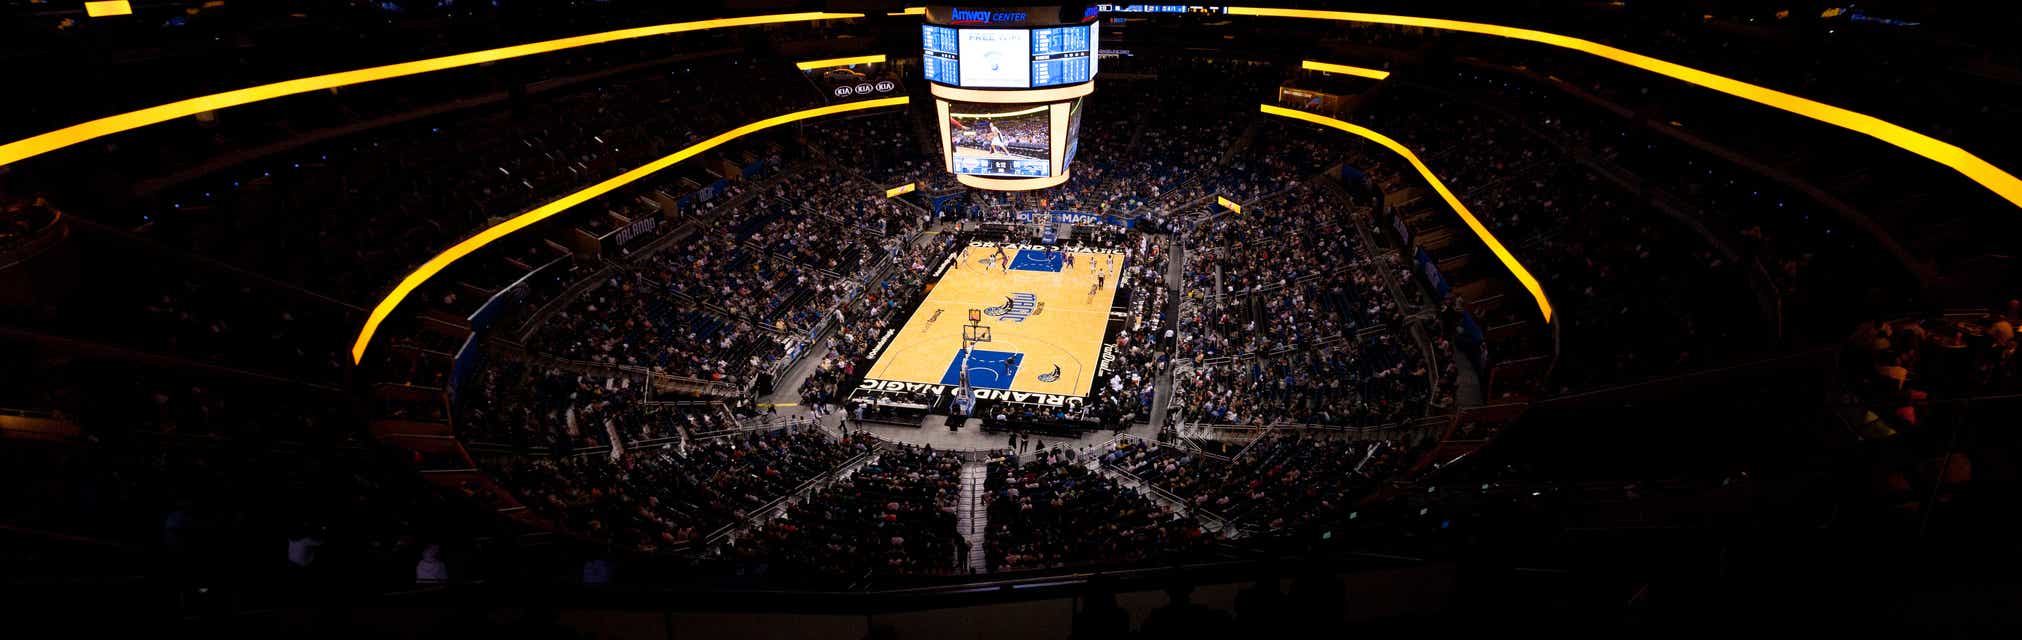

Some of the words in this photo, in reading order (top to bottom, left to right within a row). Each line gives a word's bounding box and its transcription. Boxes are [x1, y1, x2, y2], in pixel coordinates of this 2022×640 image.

[952, 7, 991, 24] Amway
[992, 12, 1028, 22] CENTER
[1062, 213, 1097, 223] MAGIC
[616, 217, 656, 247] ORLANDO
[969, 241, 1060, 251] ORANDO
[999, 291, 1038, 322] MAGIC
[861, 379, 945, 395] MAGIC
